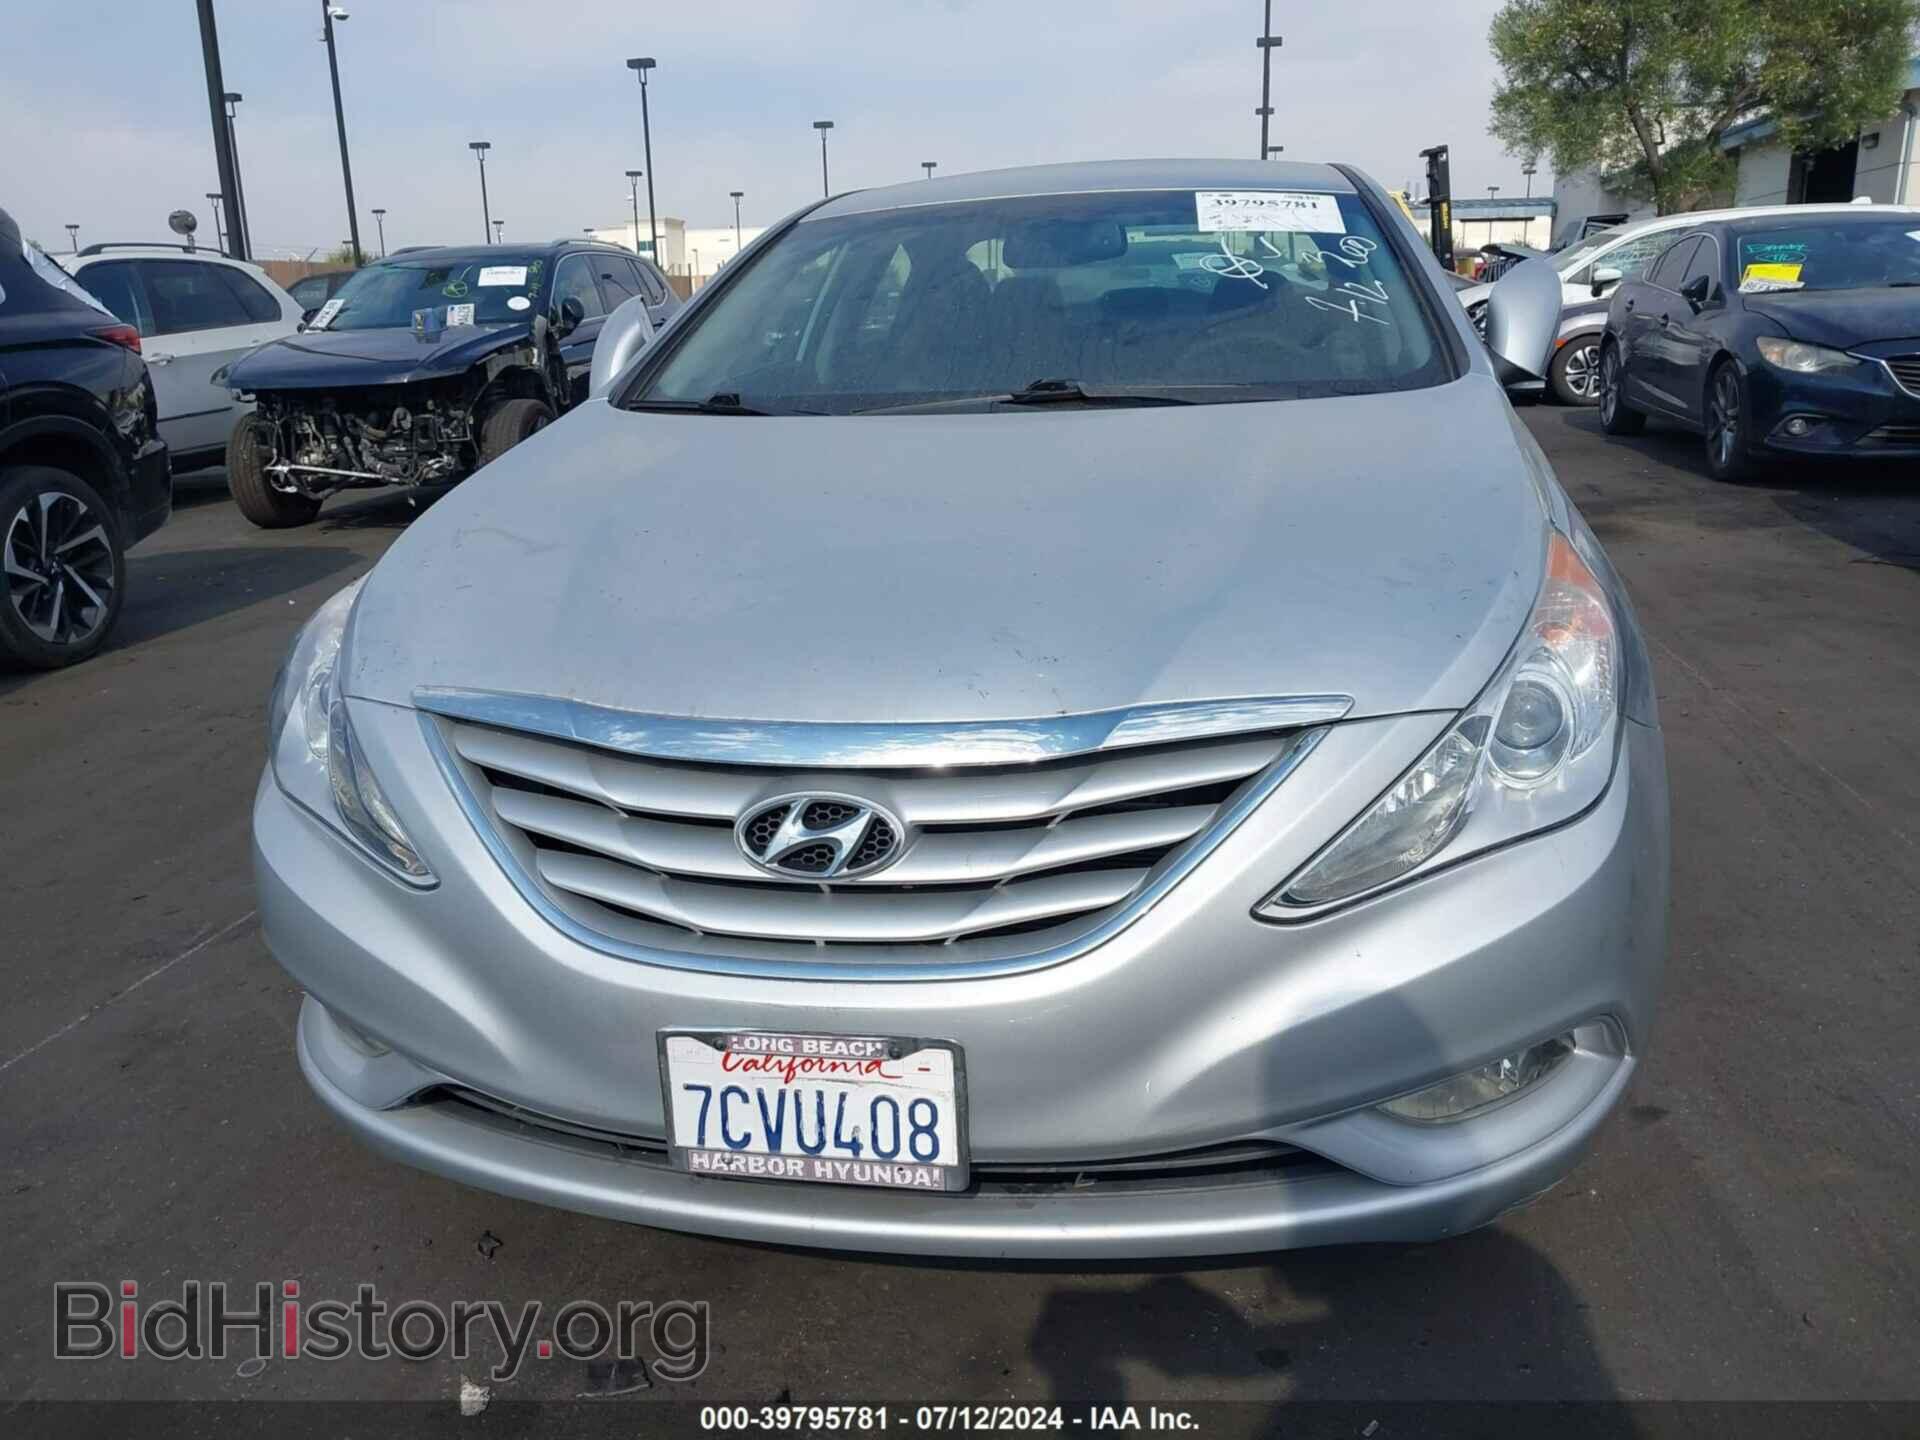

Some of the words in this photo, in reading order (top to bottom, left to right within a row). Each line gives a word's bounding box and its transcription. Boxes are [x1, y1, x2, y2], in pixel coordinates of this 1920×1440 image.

[732, 1036, 794, 1053] LONG
[802, 1039, 882, 1057] BEACH
[721, 1050, 903, 1084] California
[682, 1082, 940, 1163] 7CVU408
[692, 1152, 804, 1176] HARBOR
[814, 1160, 940, 1188] HYUNDAI
